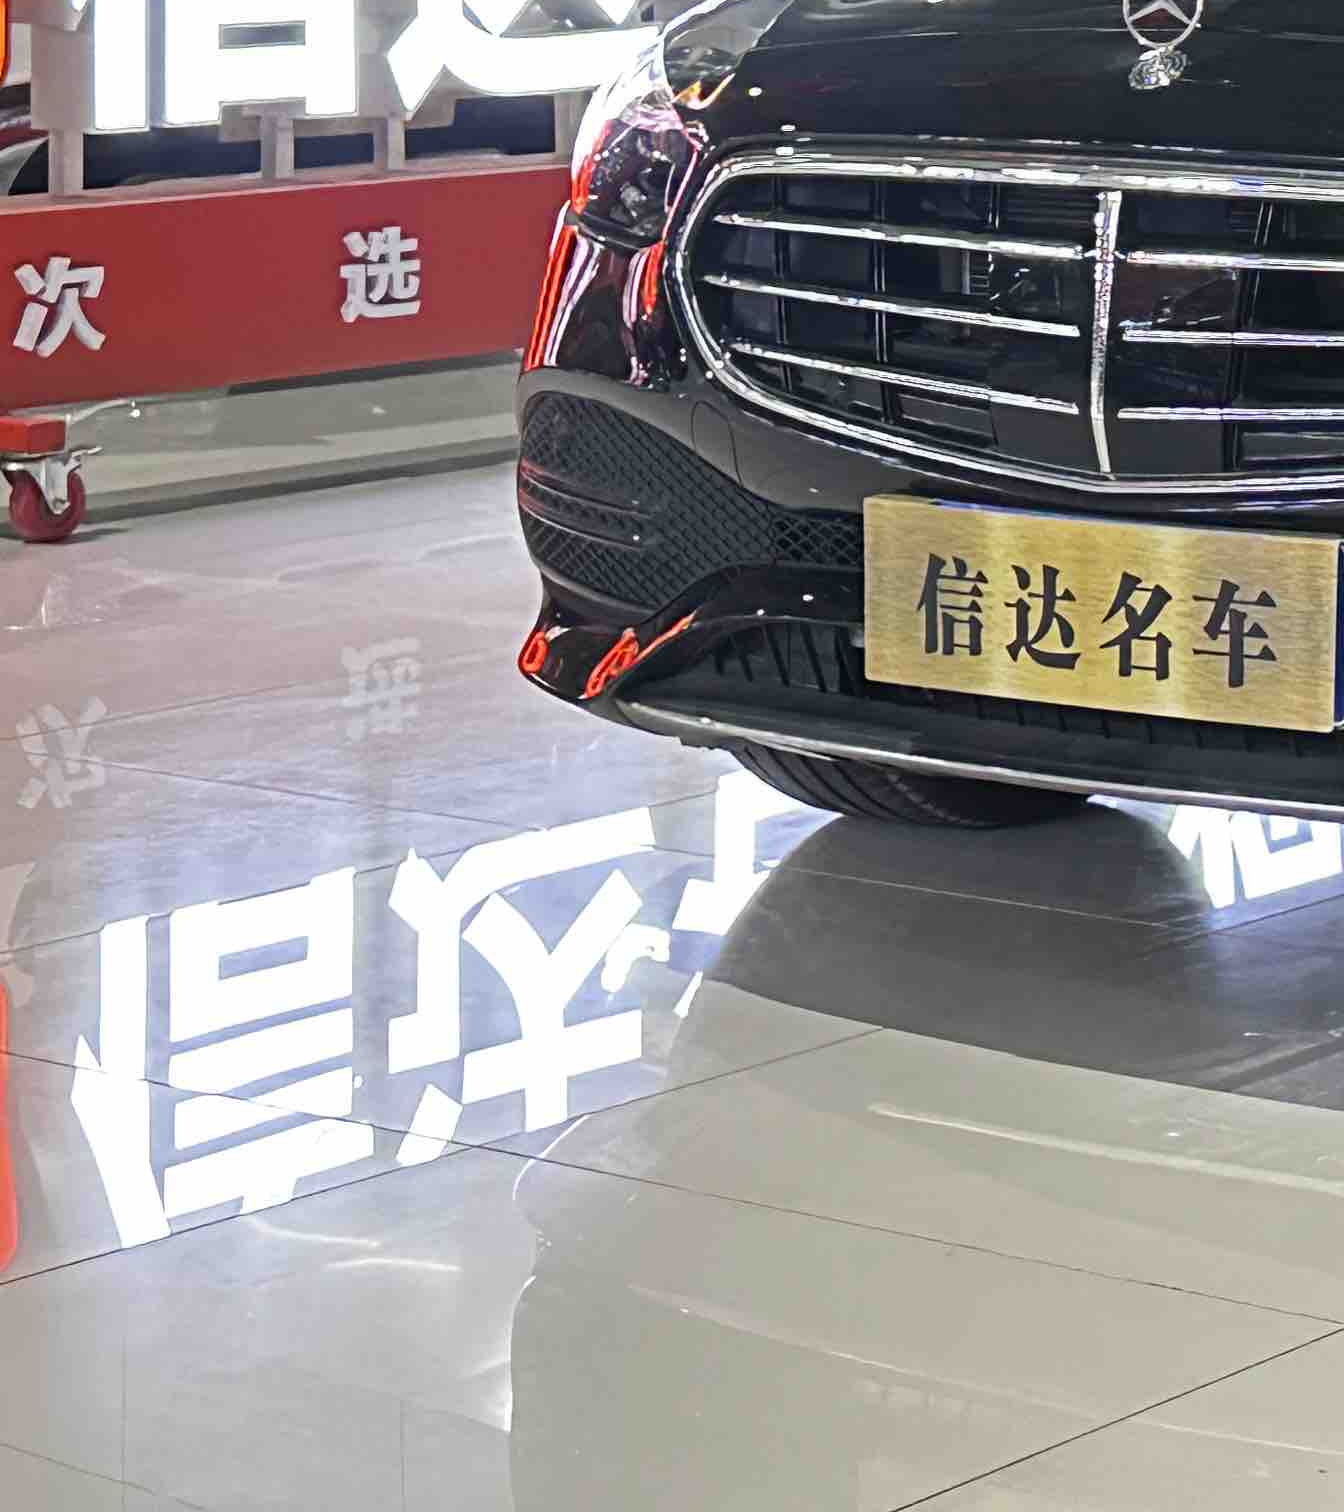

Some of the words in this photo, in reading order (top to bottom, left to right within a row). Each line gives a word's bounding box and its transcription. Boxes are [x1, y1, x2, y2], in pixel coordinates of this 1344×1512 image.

[13, 255, 106, 357] 次
[340, 226, 422, 323] 选
[914, 550, 1280, 690] 信达名车
